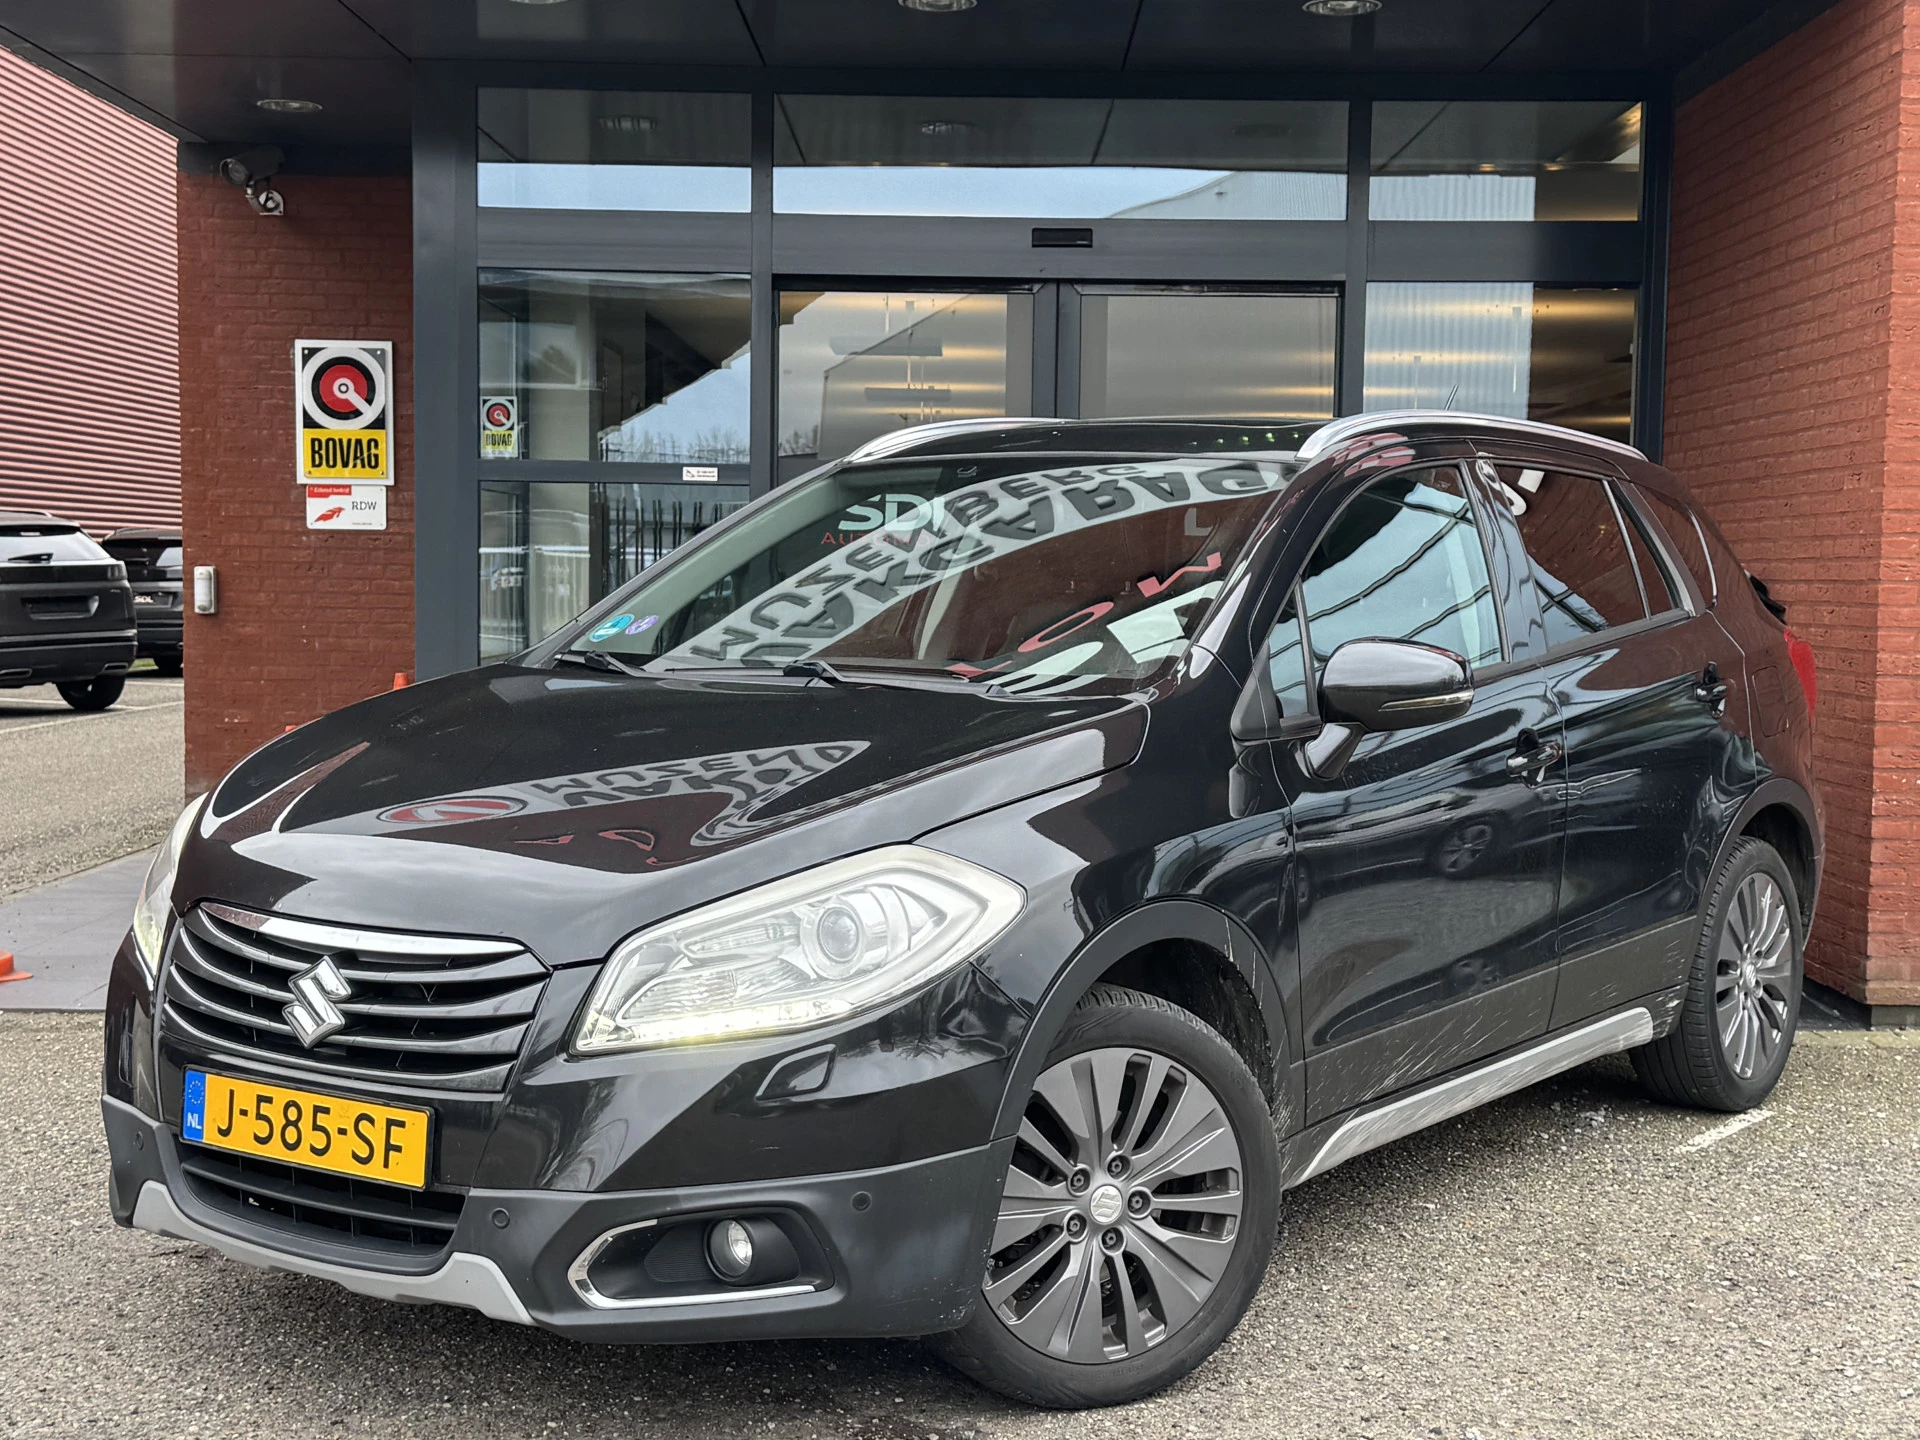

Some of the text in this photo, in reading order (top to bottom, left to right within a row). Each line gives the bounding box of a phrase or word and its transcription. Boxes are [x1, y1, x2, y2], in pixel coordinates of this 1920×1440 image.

[485, 433, 513, 447] BOVAG
[310, 436, 380, 469] BOVAG
[351, 501, 377, 511] RDW
[187, 1111, 202, 1130] NL
[217, 1088, 406, 1169] J-585-SF
